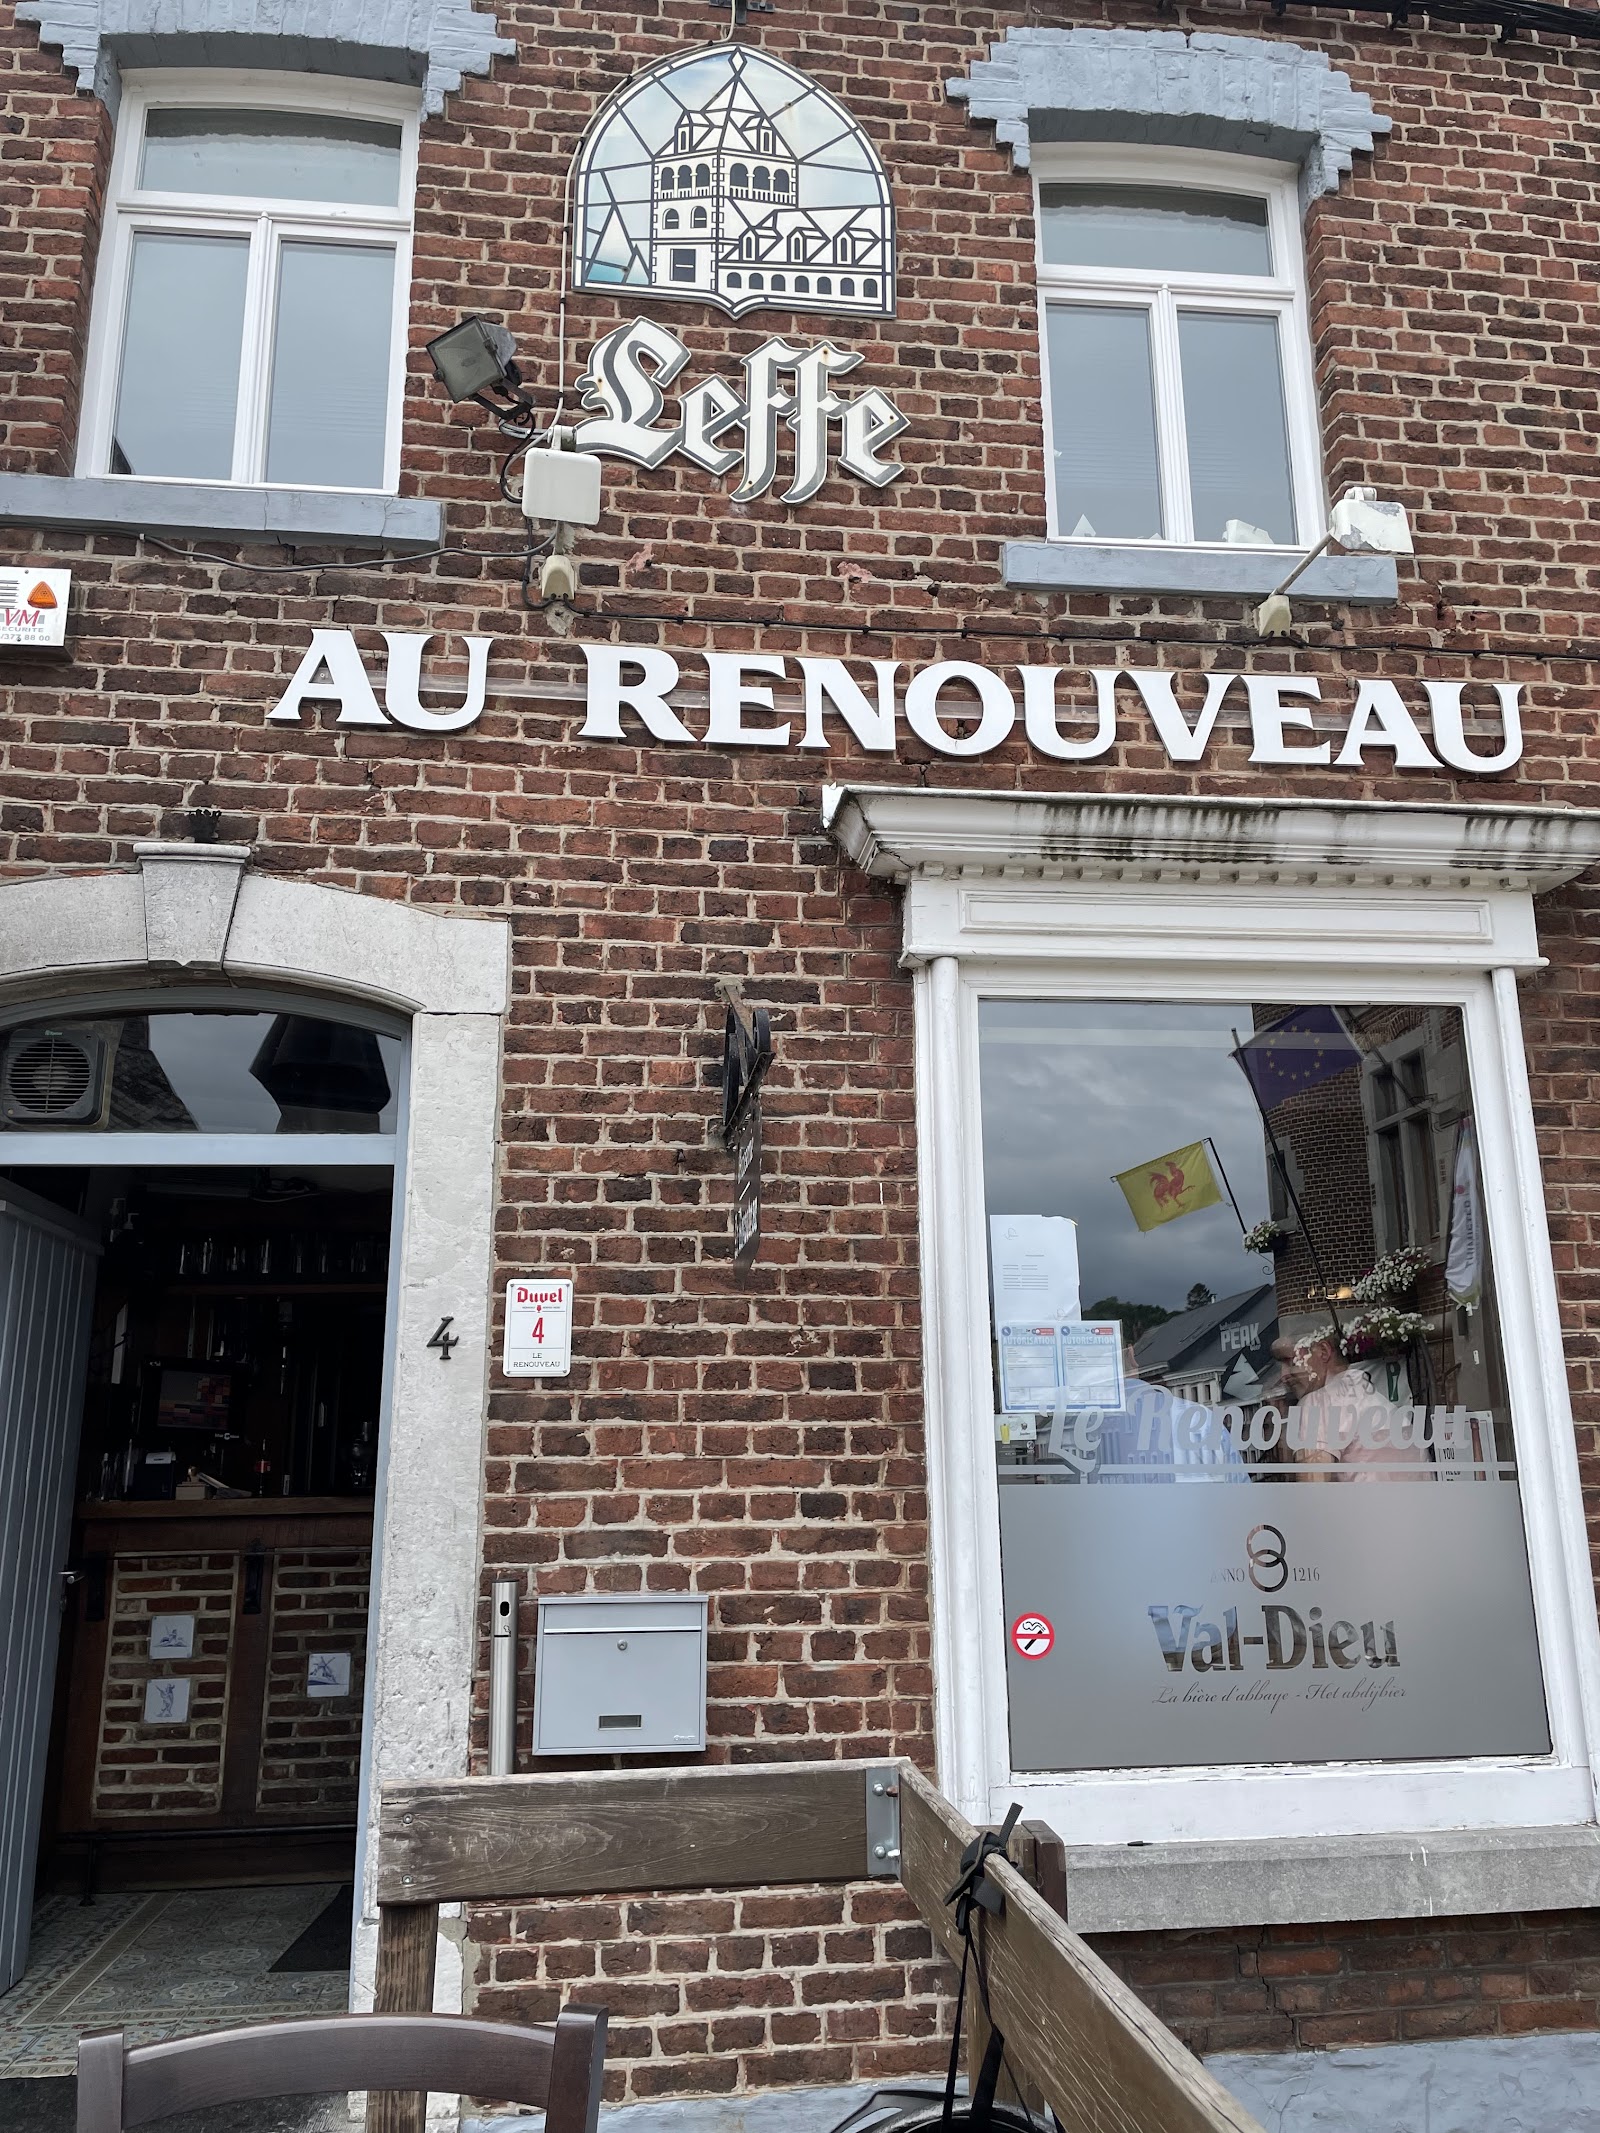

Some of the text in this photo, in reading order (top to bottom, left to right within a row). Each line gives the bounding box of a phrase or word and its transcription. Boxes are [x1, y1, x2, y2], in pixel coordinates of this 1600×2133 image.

[574, 315, 911, 504] Leffe
[265, 628, 1524, 774] AU RENOUVEAU
[516, 1286, 563, 1303] Duvel
[426, 1316, 460, 1360] 4
[531, 1317, 545, 1344] 4
[1003, 1336, 1056, 1345] AUTORISATION
[1062, 1335, 1115, 1344] AUTORISATION
[1220, 1322, 1261, 1352] PEAK
[1038, 1384, 1473, 1474] Le Renouveau
[1210, 1567, 1320, 1583] ANNO 1216
[1148, 1604, 1400, 1673] Val-Dieu
[1152, 1686, 1177, 1704] La
[1182, 1681, 1218, 1703] bière
[1221, 1680, 1290, 1714] d'abbaye
[1305, 1684, 1337, 1700] Het
[1341, 1677, 1407, 1712] abdijbier
